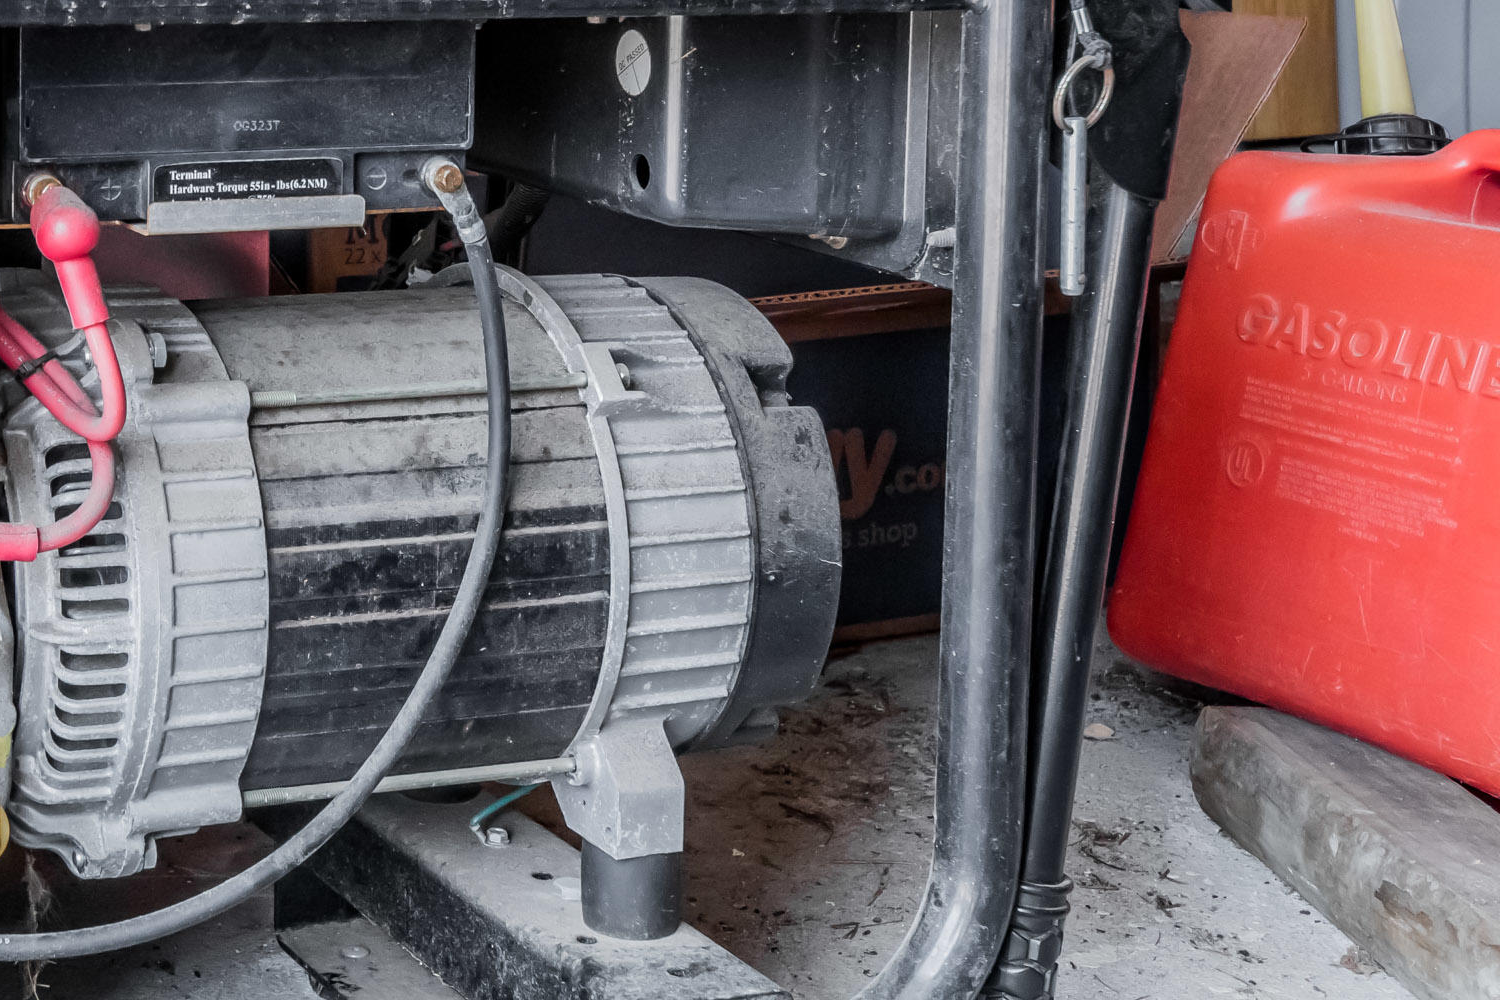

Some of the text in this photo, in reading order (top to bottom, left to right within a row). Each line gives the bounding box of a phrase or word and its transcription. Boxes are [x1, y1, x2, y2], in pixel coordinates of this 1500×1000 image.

[169, 169, 212, 180] Terminal
[169, 183, 215, 195] Hardware
[216, 182, 248, 194] Torque
